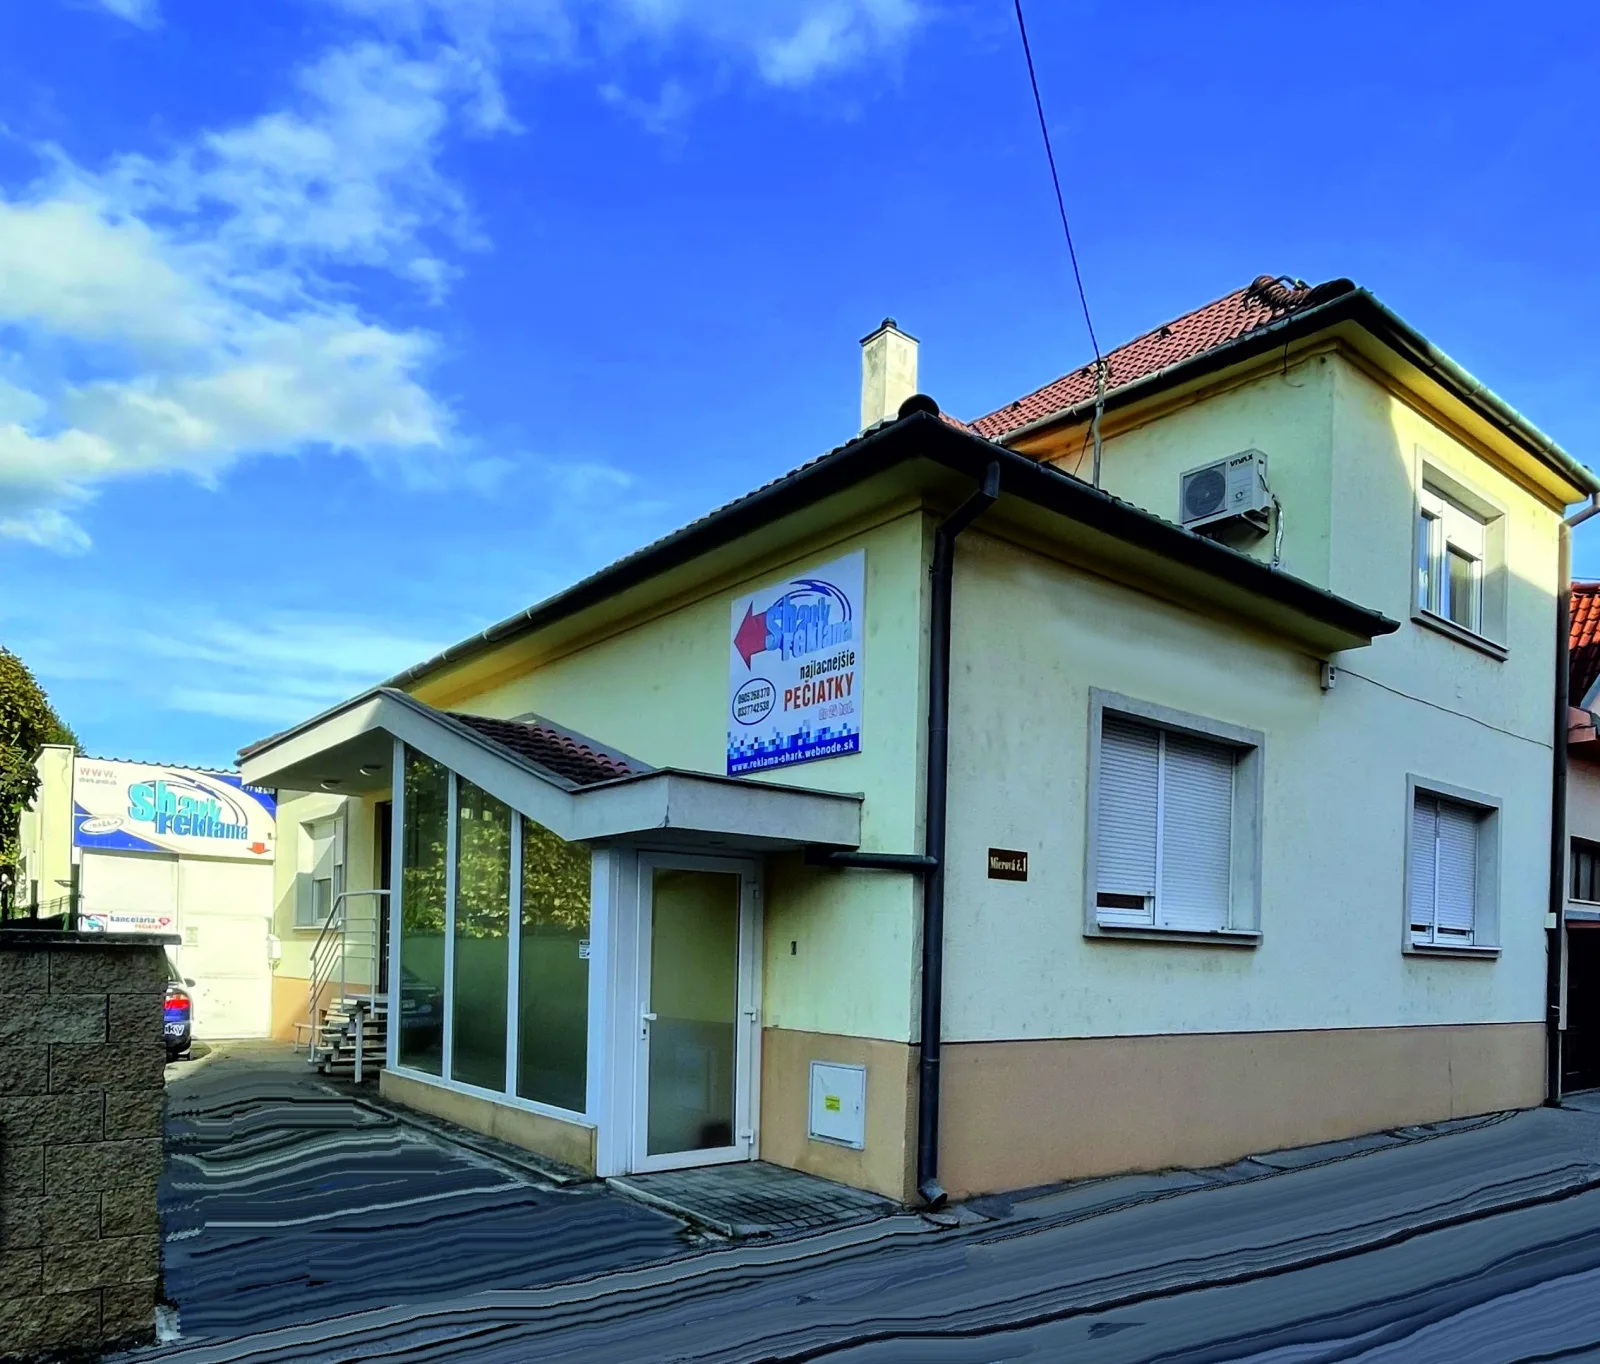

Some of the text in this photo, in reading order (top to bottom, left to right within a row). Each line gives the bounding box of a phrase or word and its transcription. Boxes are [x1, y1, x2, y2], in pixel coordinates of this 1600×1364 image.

[1230, 453, 1253, 467] VIVAX
[782, 620, 852, 661] reklama
[800, 649, 855, 680] najlacnejšie
[784, 671, 854, 712] PEČIATKY
[731, 739, 854, 772] www.reklama-shark.webnode.sk
[155, 811, 248, 840] reklama
